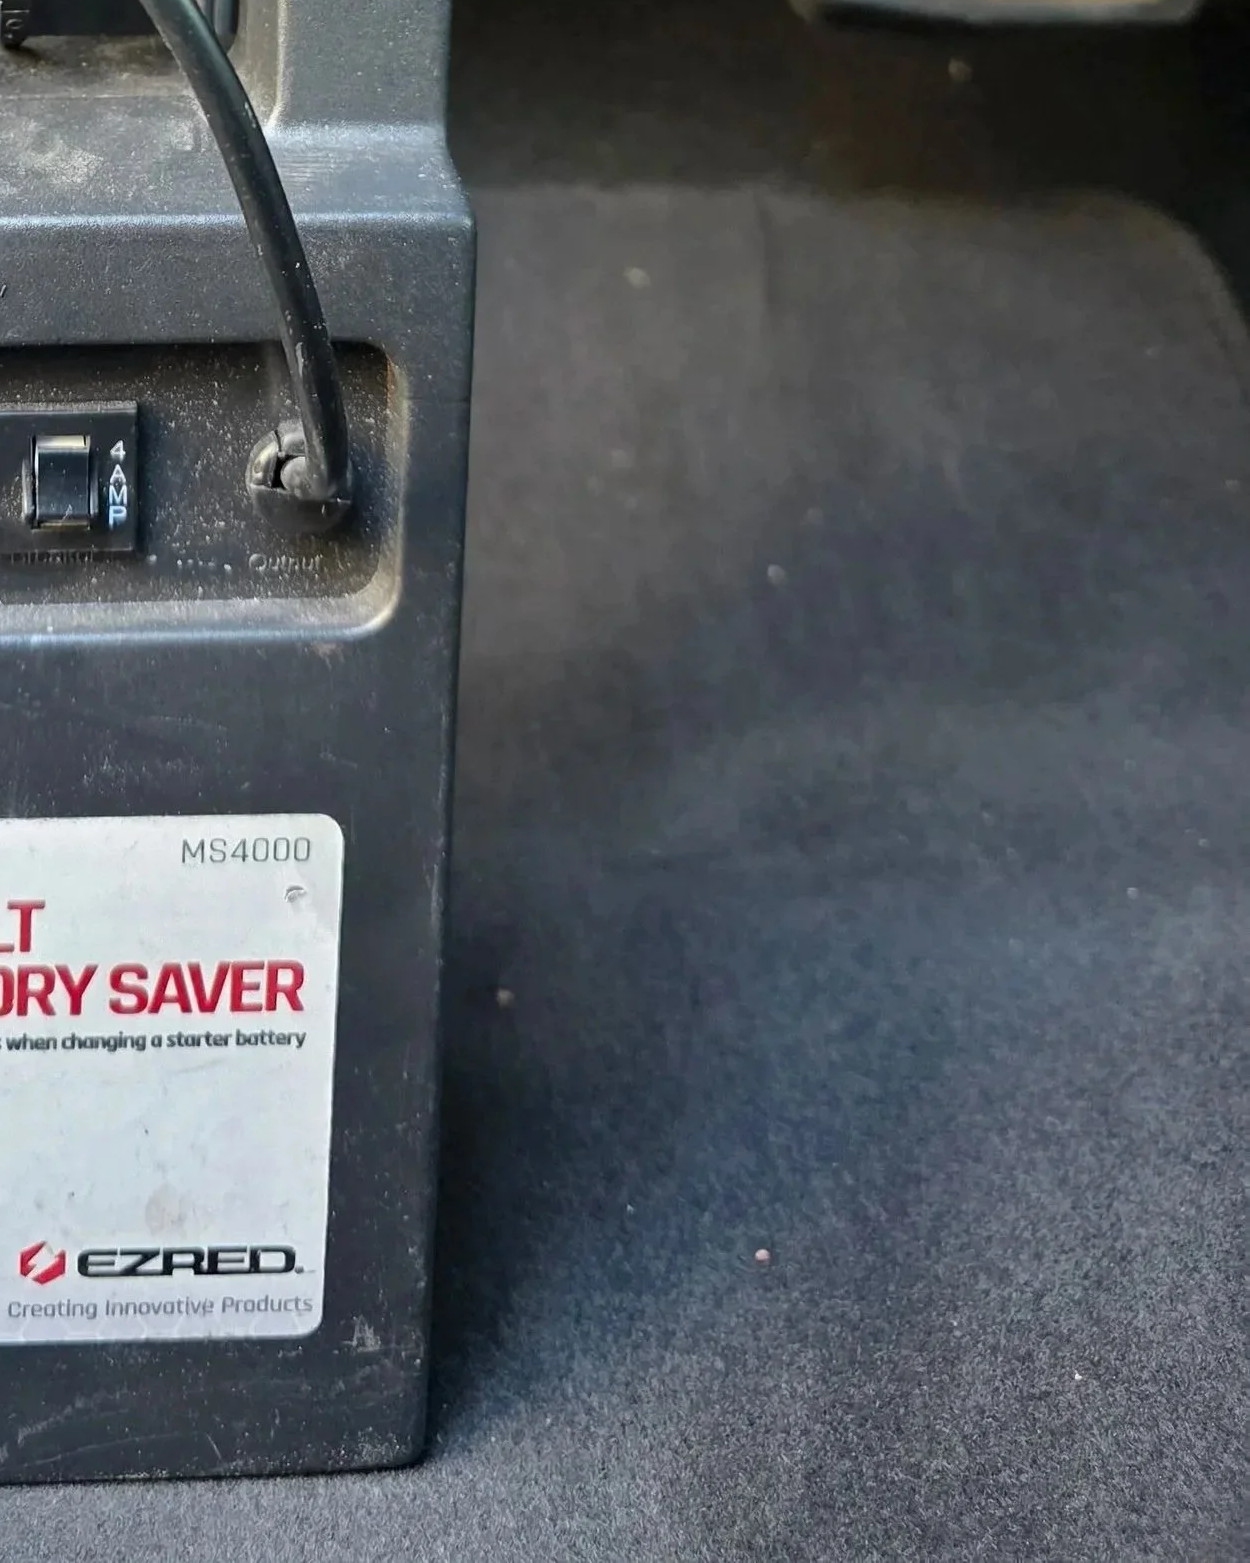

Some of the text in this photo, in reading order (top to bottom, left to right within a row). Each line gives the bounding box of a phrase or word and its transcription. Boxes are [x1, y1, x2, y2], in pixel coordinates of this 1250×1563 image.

[108, 439, 128, 530] 4 AMP
[182, 837, 311, 864] MS4000
[109, 960, 305, 1015] SAVER
[6, 1033, 57, 1053] when
[61, 1031, 147, 1054] changing
[151, 1034, 162, 1049] a
[167, 1031, 232, 1048] starter
[235, 1029, 306, 1050] battery
[8, 1294, 312, 1320] Creating Innovative Products
